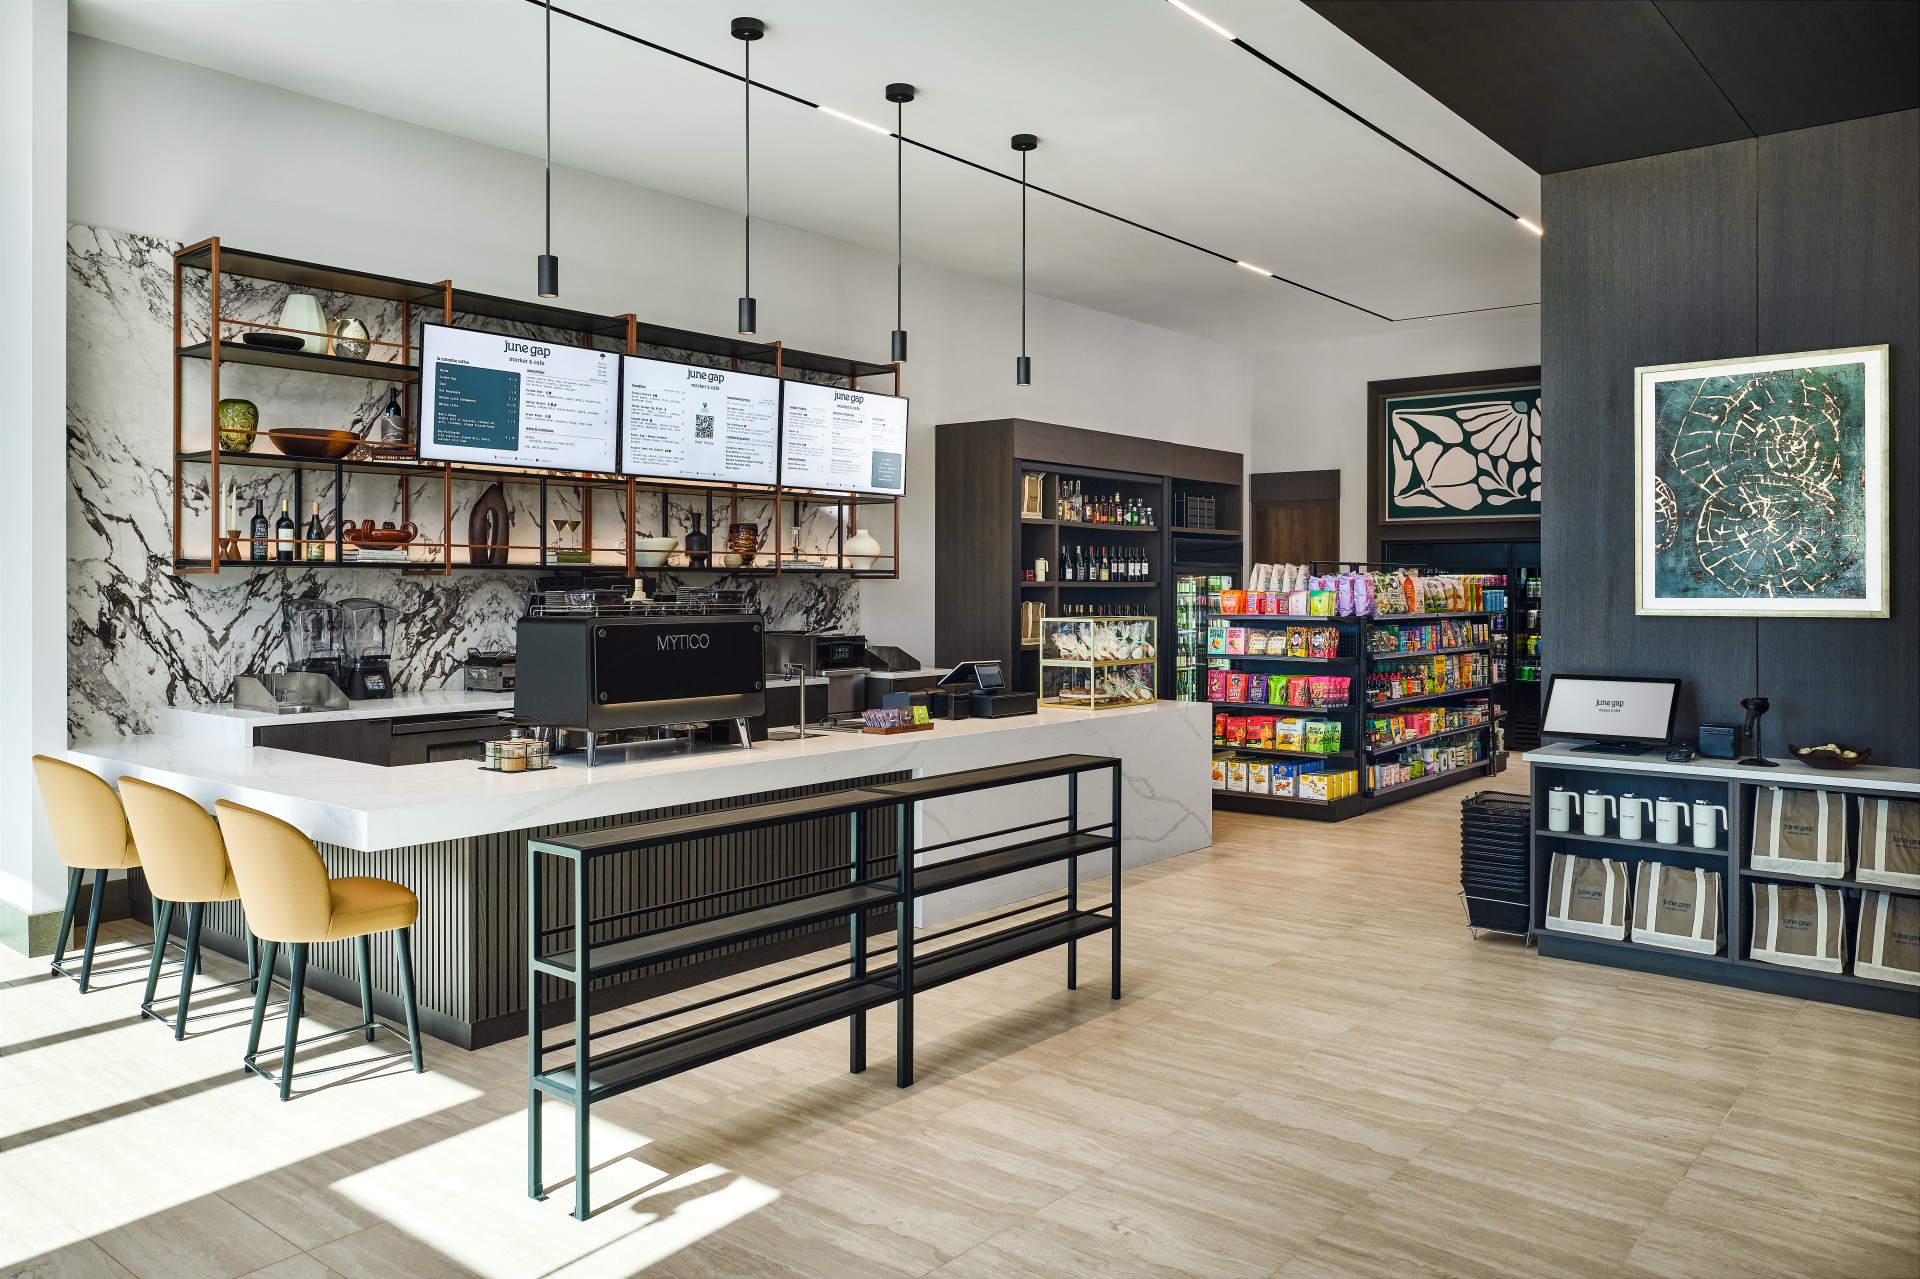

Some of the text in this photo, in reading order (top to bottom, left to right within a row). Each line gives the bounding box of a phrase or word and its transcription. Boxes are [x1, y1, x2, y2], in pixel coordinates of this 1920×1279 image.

[504, 340, 551, 358] june gap
[687, 368, 725, 384] june gap
[834, 391, 865, 405] june gap
[657, 634, 709, 650] MYTICO
[1595, 699, 1625, 708] june gap
